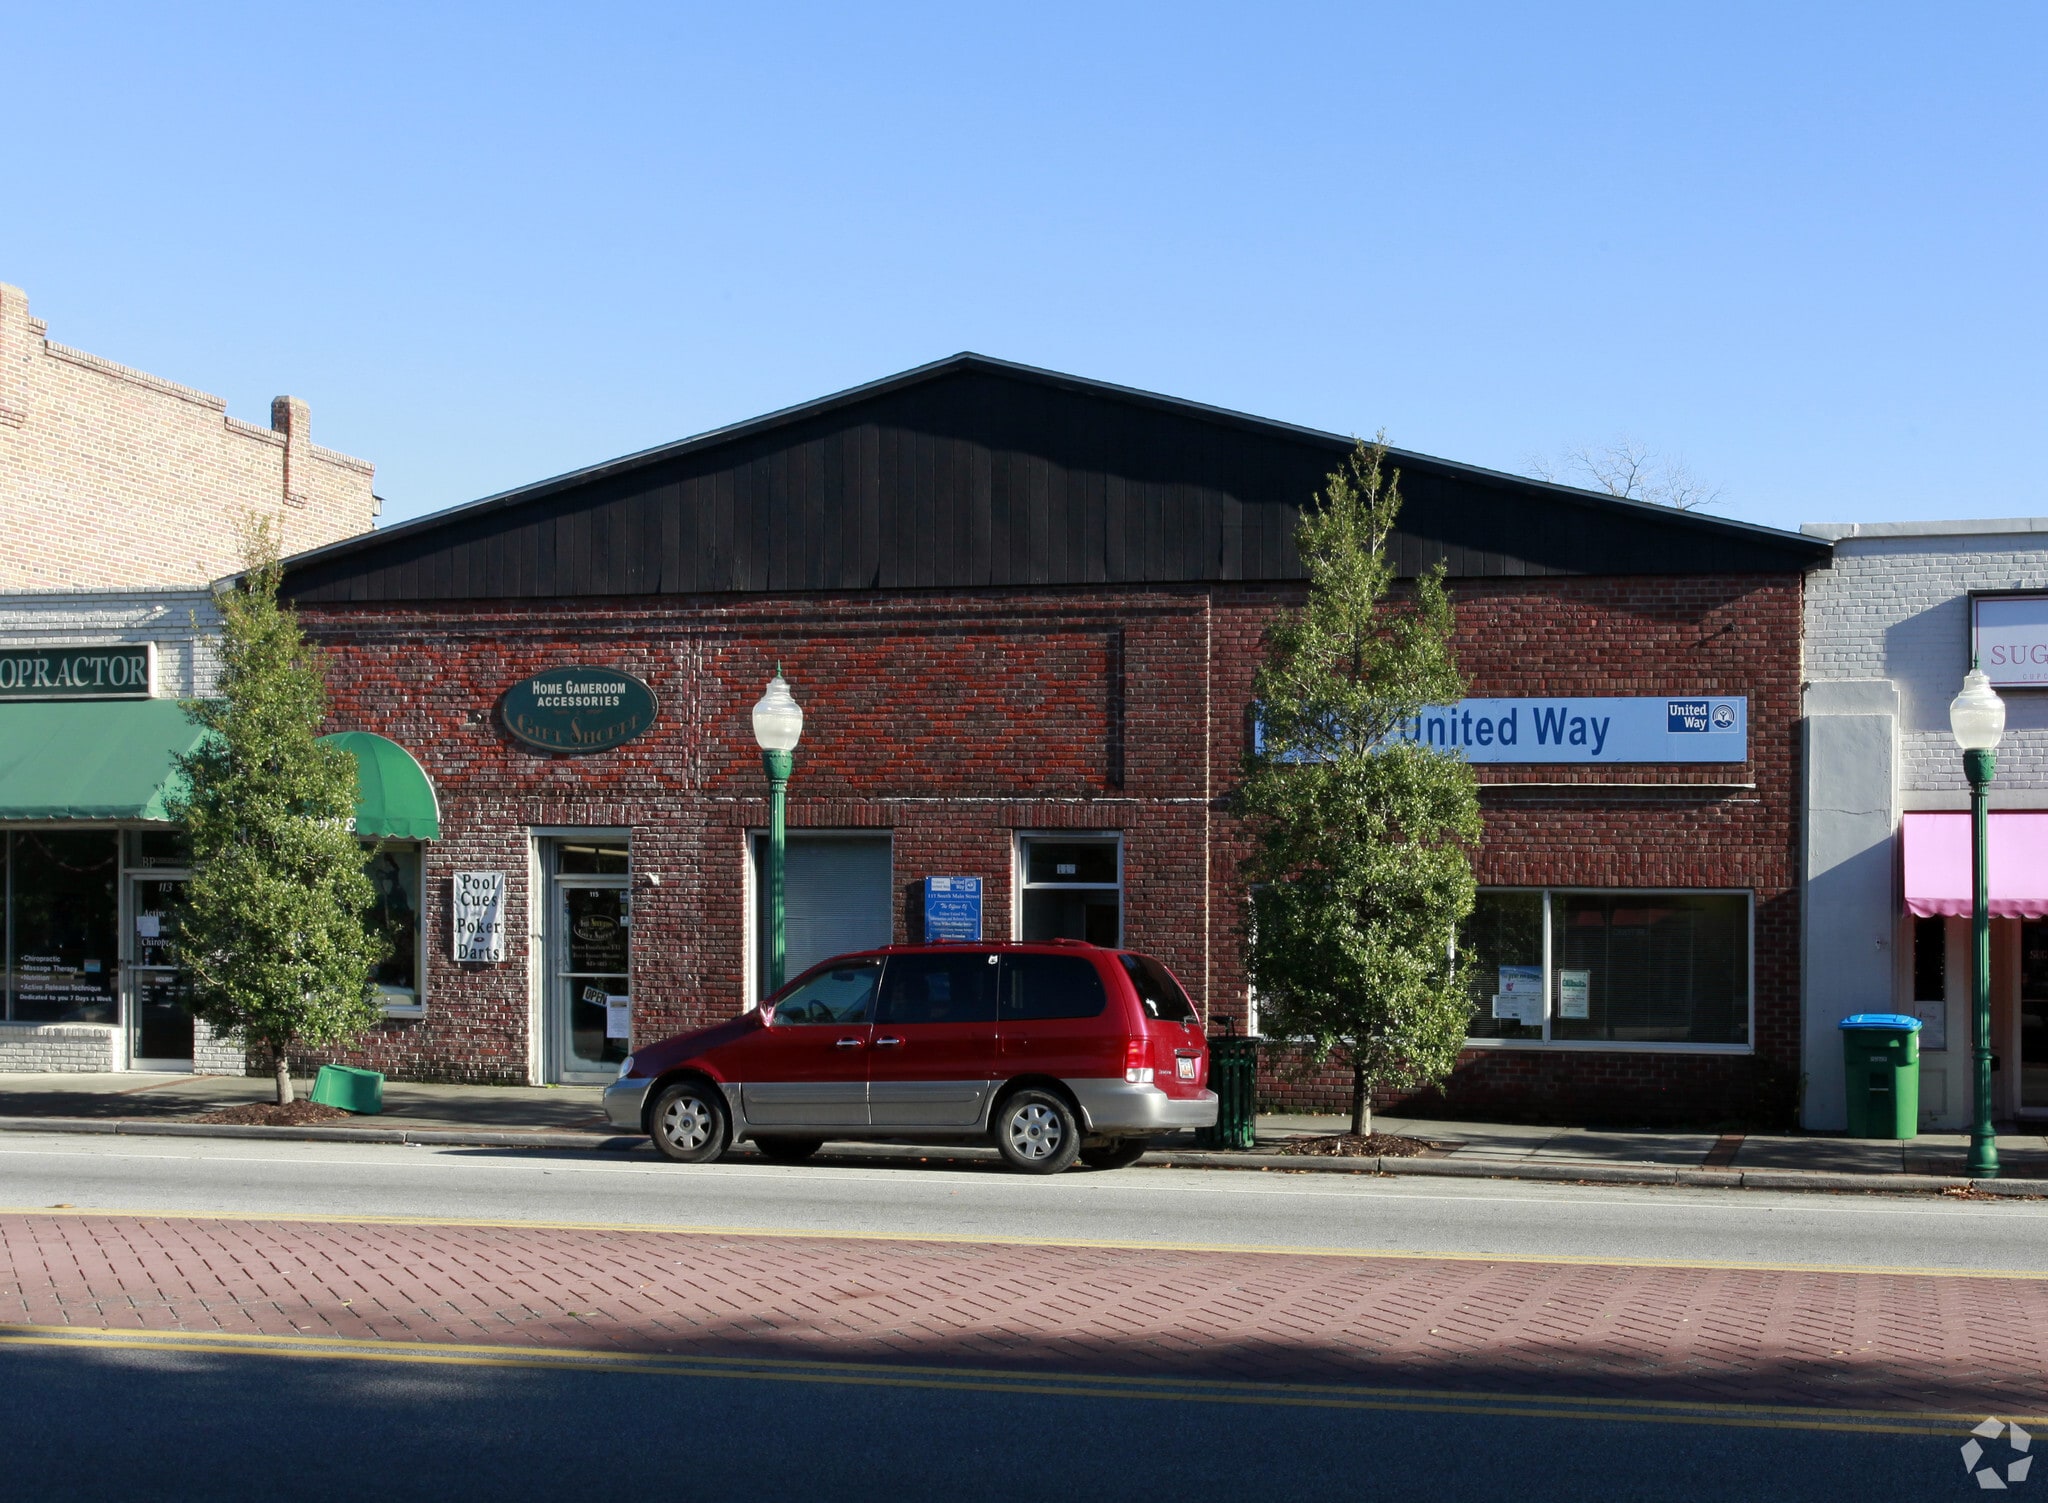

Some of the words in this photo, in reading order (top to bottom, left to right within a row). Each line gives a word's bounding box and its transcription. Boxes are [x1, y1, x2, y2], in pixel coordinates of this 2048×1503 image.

[0, 655, 148, 689] OPRACTOR
[532, 681, 562, 695] HOME
[565, 680, 626, 695] GAMEROOM
[537, 696, 620, 707] ACCESSORIES
[1669, 704, 1707, 716] United
[1684, 716, 1707, 730] Way
[1533, 707, 1610, 755] Way
[158, 882, 173, 892] 113
[463, 874, 496, 889] Pool
[461, 891, 498, 907] Cues
[457, 918, 501, 934] Poker
[24, 955, 61, 963] Chiropractic
[458, 944, 500, 960] Darts
[53, 965, 78, 974] Therapy
[71, 984, 102, 992] Technique
[584, 988, 608, 1006] OPEN
